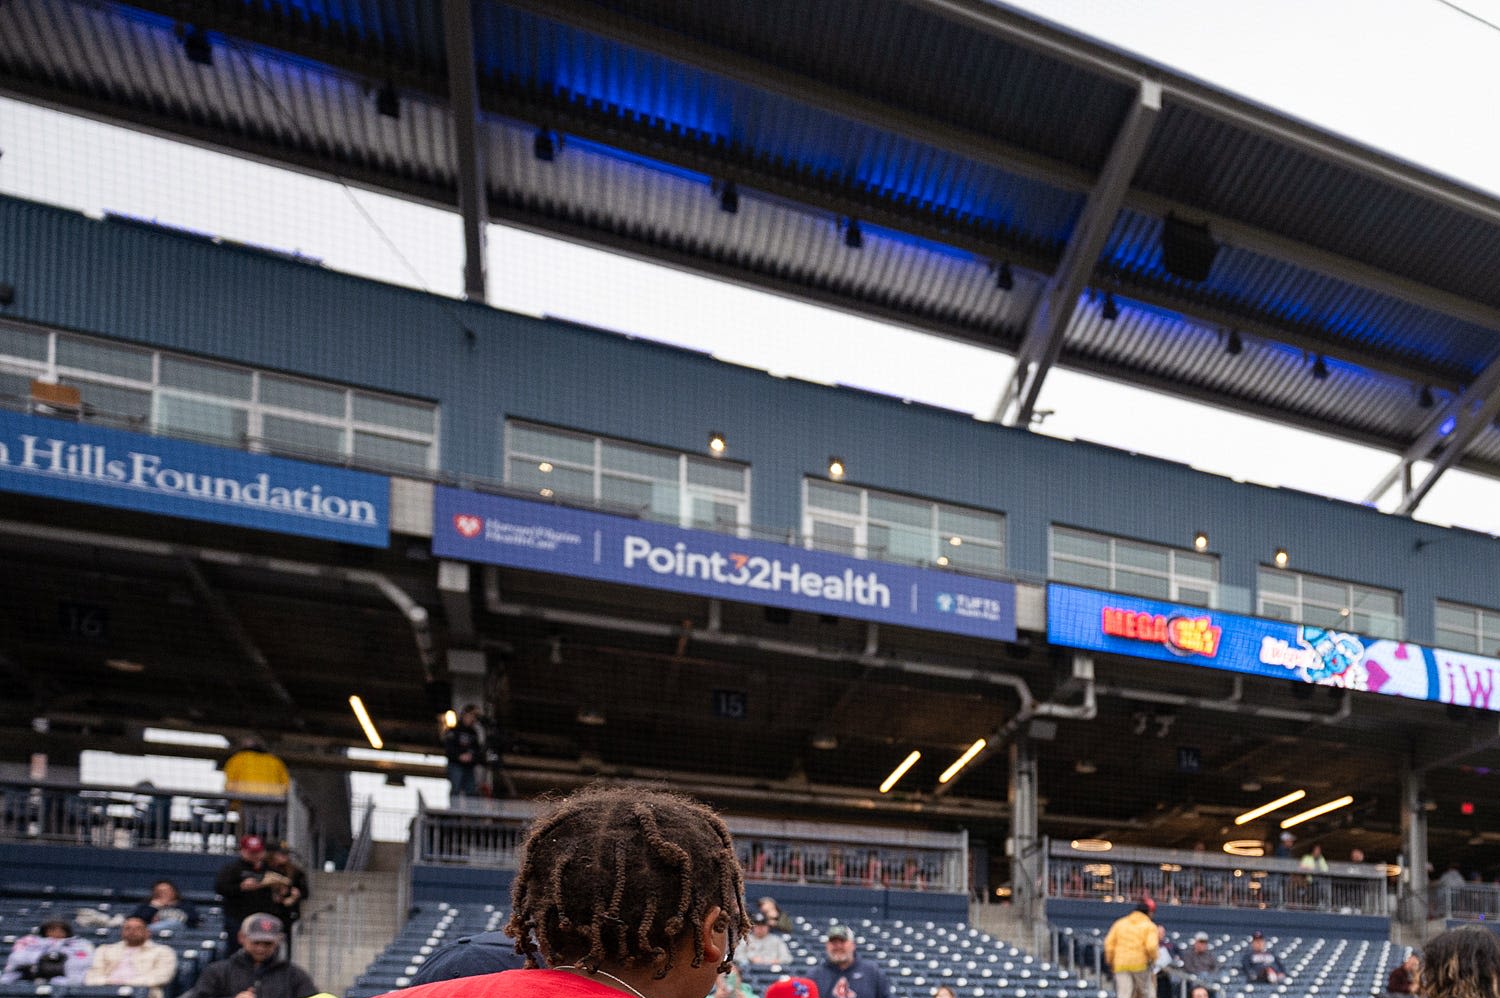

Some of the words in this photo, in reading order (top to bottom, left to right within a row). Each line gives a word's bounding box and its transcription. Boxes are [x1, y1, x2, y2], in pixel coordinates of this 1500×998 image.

[623, 534, 891, 609] Point32Health
[1102, 607, 1168, 643] MEGA
[719, 693, 745, 718] 15
